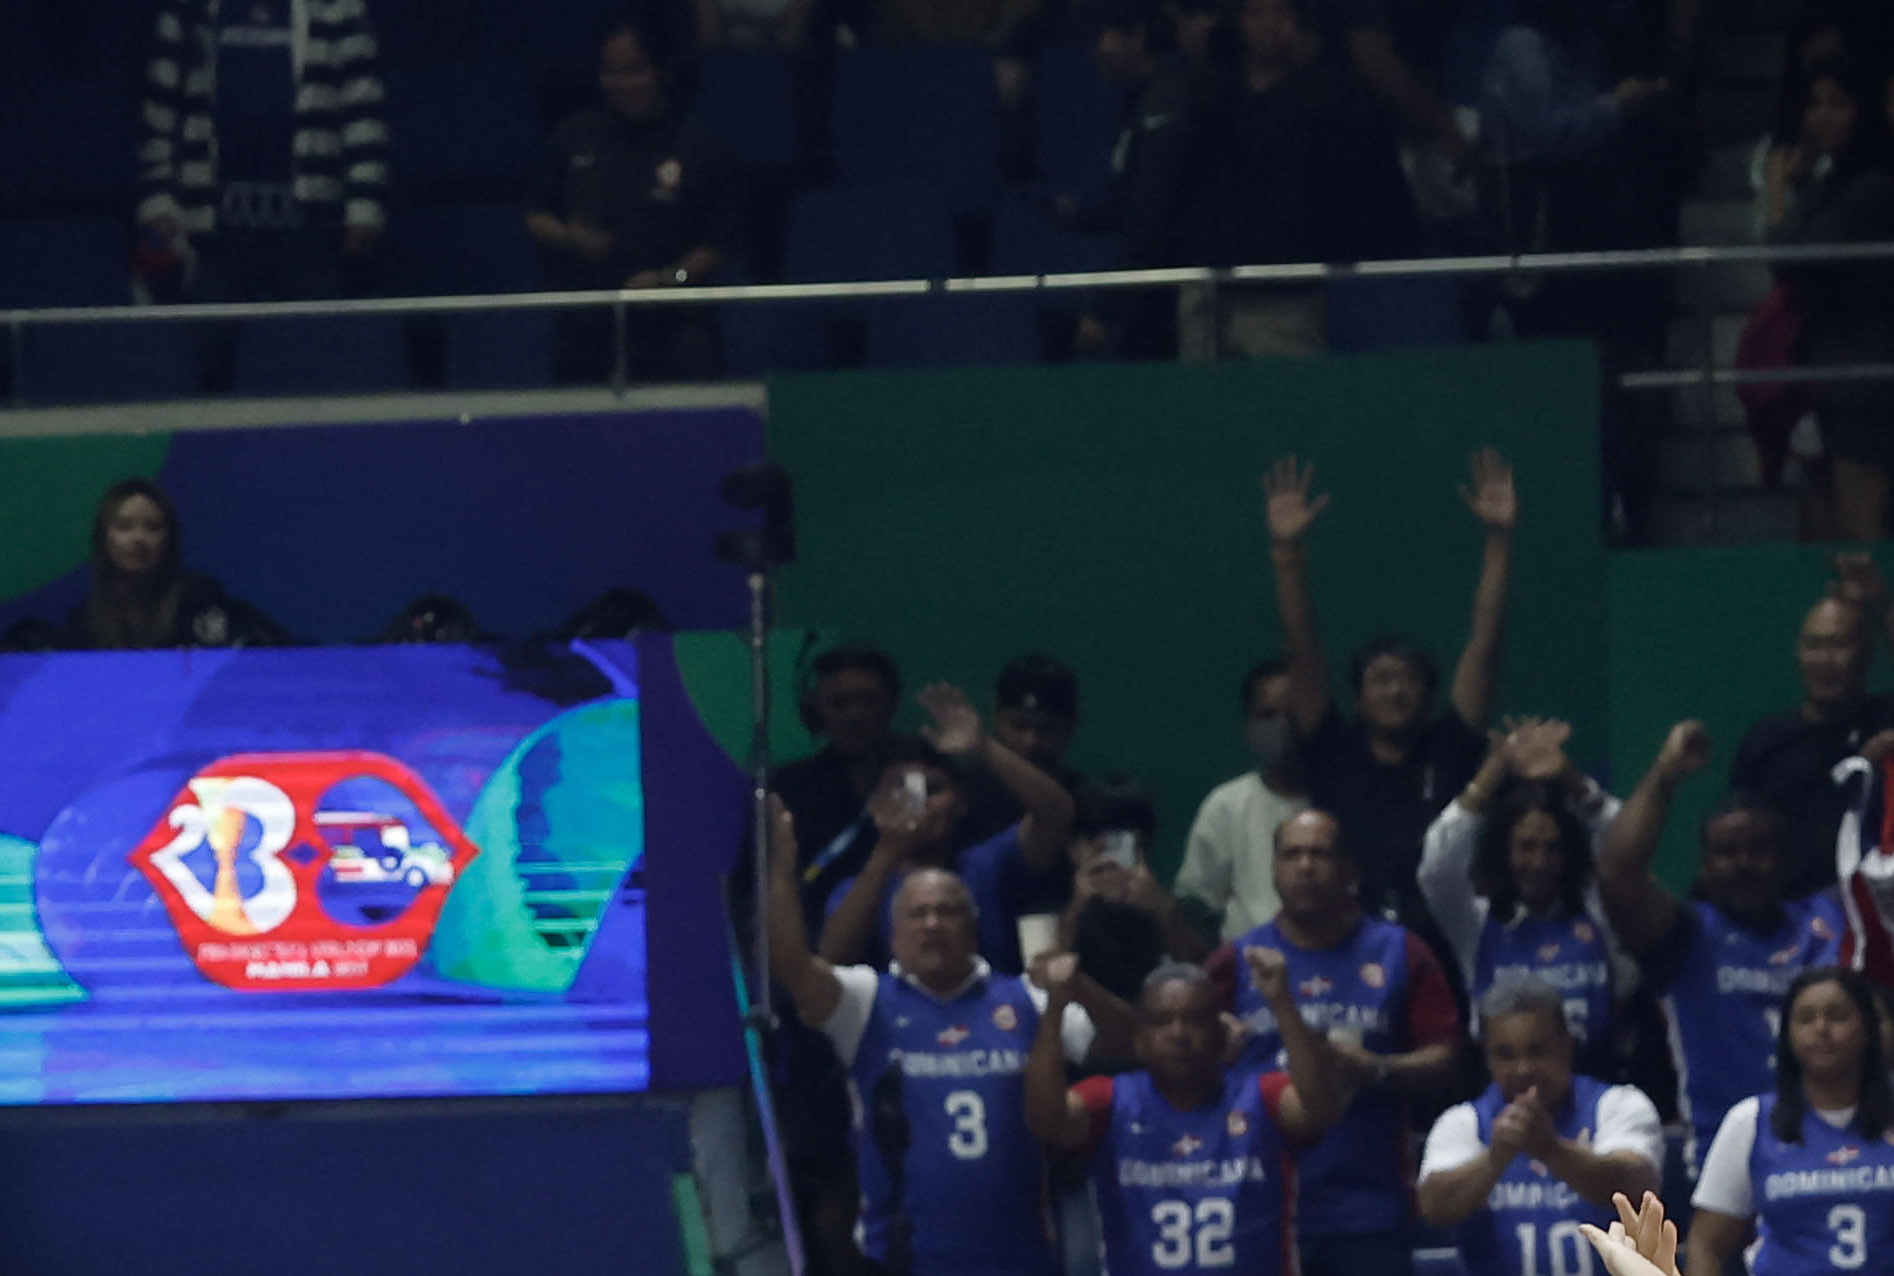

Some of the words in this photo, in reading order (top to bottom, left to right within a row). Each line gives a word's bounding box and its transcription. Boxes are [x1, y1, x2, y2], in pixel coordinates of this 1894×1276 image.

[944, 1089, 989, 1160] 3
[1150, 1196, 1236, 1270] 32
[1827, 1203, 1868, 1270] 3
